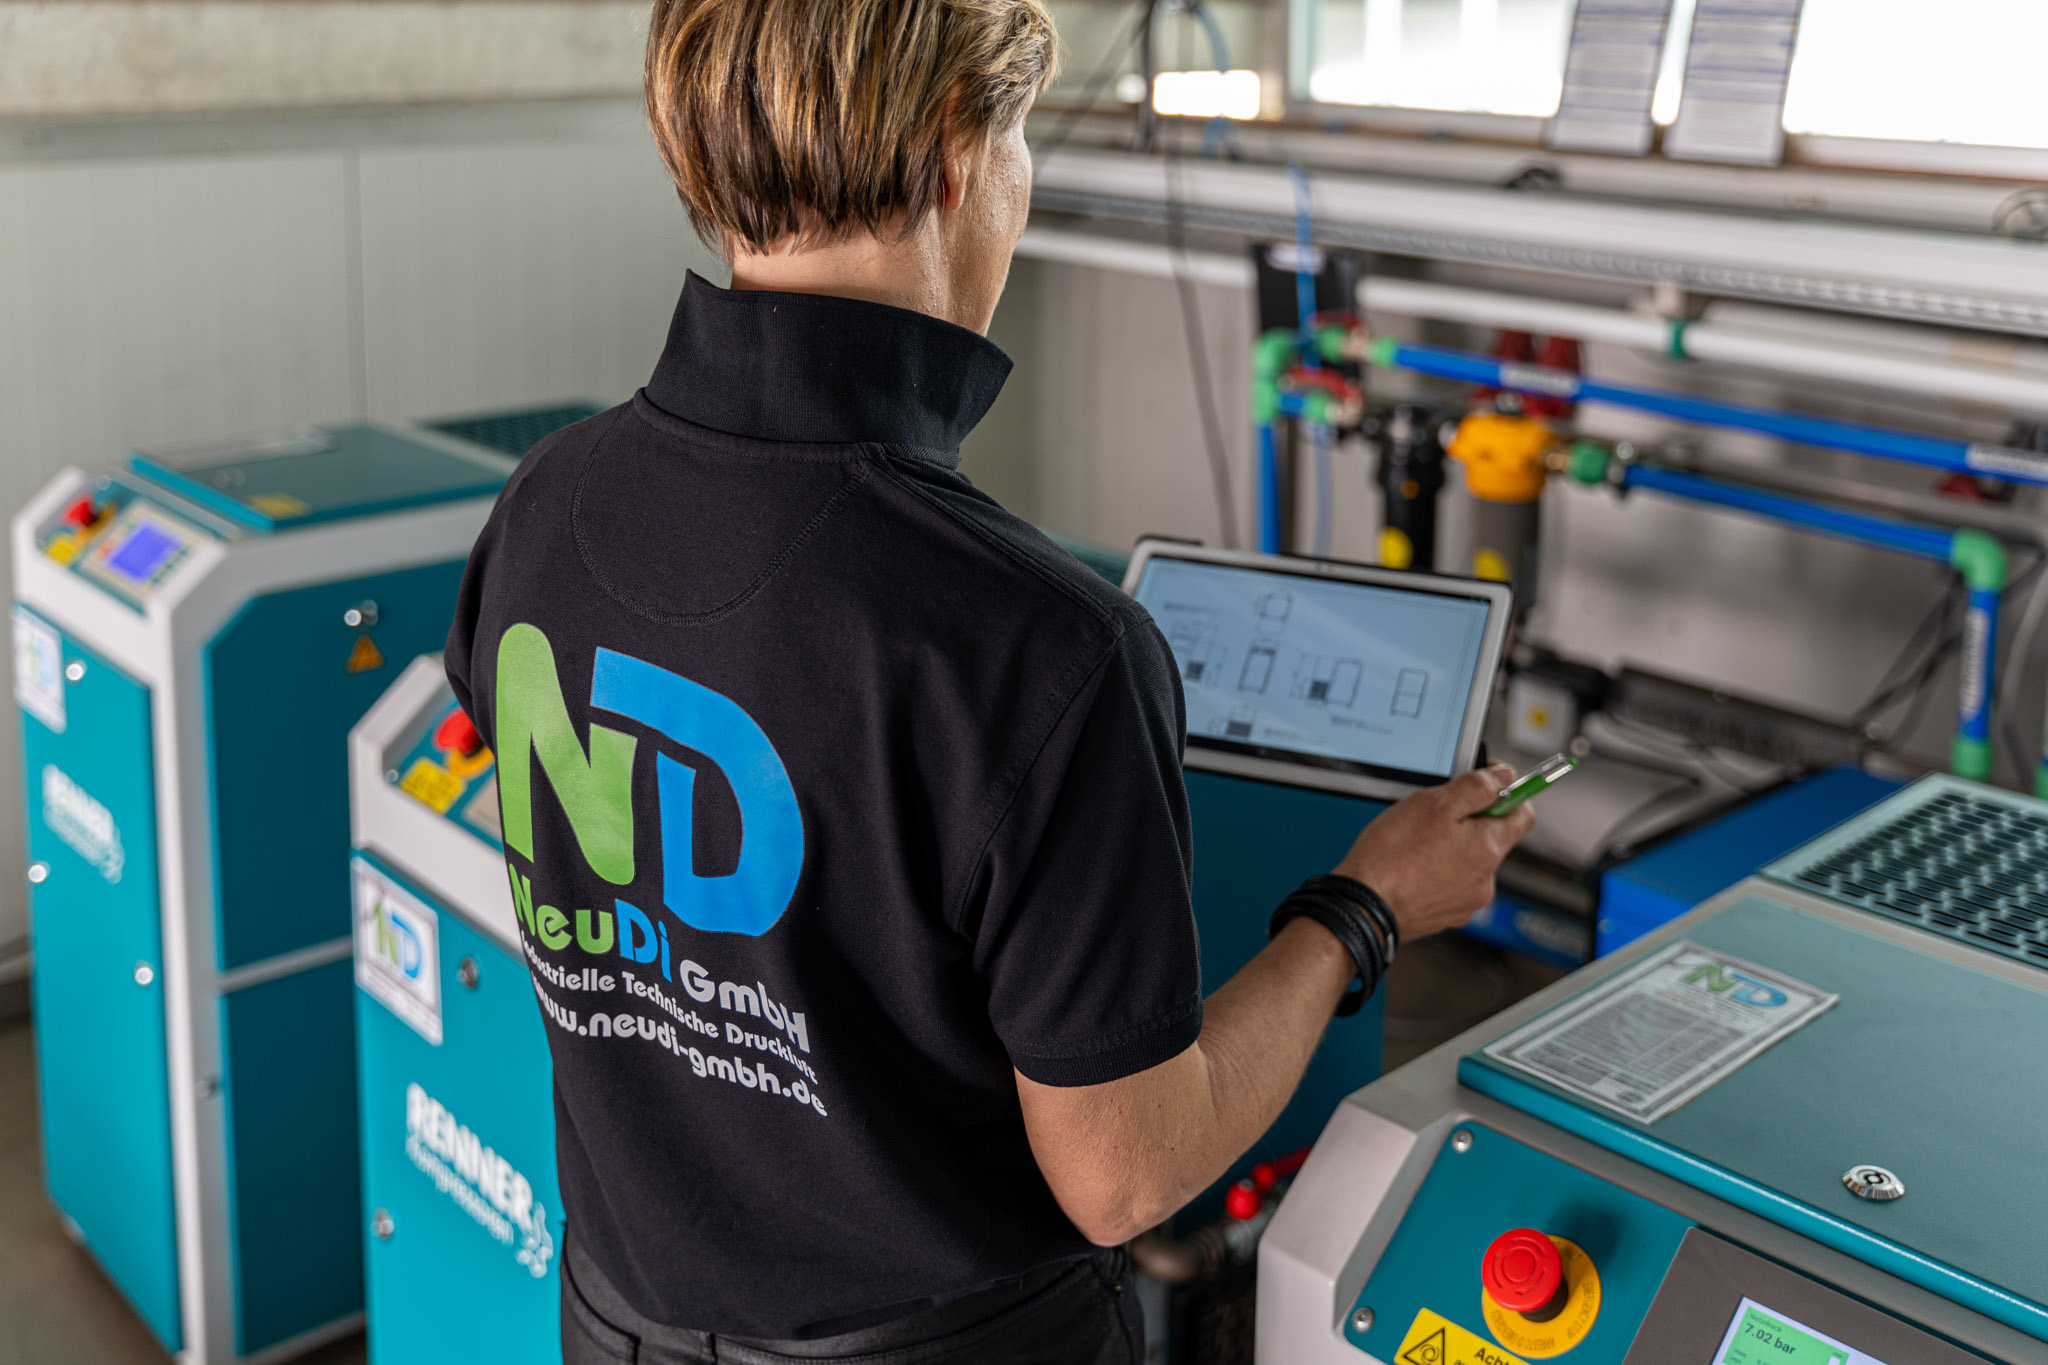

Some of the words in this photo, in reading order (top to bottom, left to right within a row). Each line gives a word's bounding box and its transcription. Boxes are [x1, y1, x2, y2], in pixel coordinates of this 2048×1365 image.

[497, 622, 804, 937] ND
[509, 863, 672, 983] NeuDi
[680, 959, 810, 1054] GmbH
[622, 970, 719, 1039] Technische
[726, 1022, 818, 1085] Druckluft
[1744, 1322, 1773, 1345] 7.02
[1773, 1337, 1796, 1356] bar
[1750, 1313, 1783, 1334] Netzdruck
